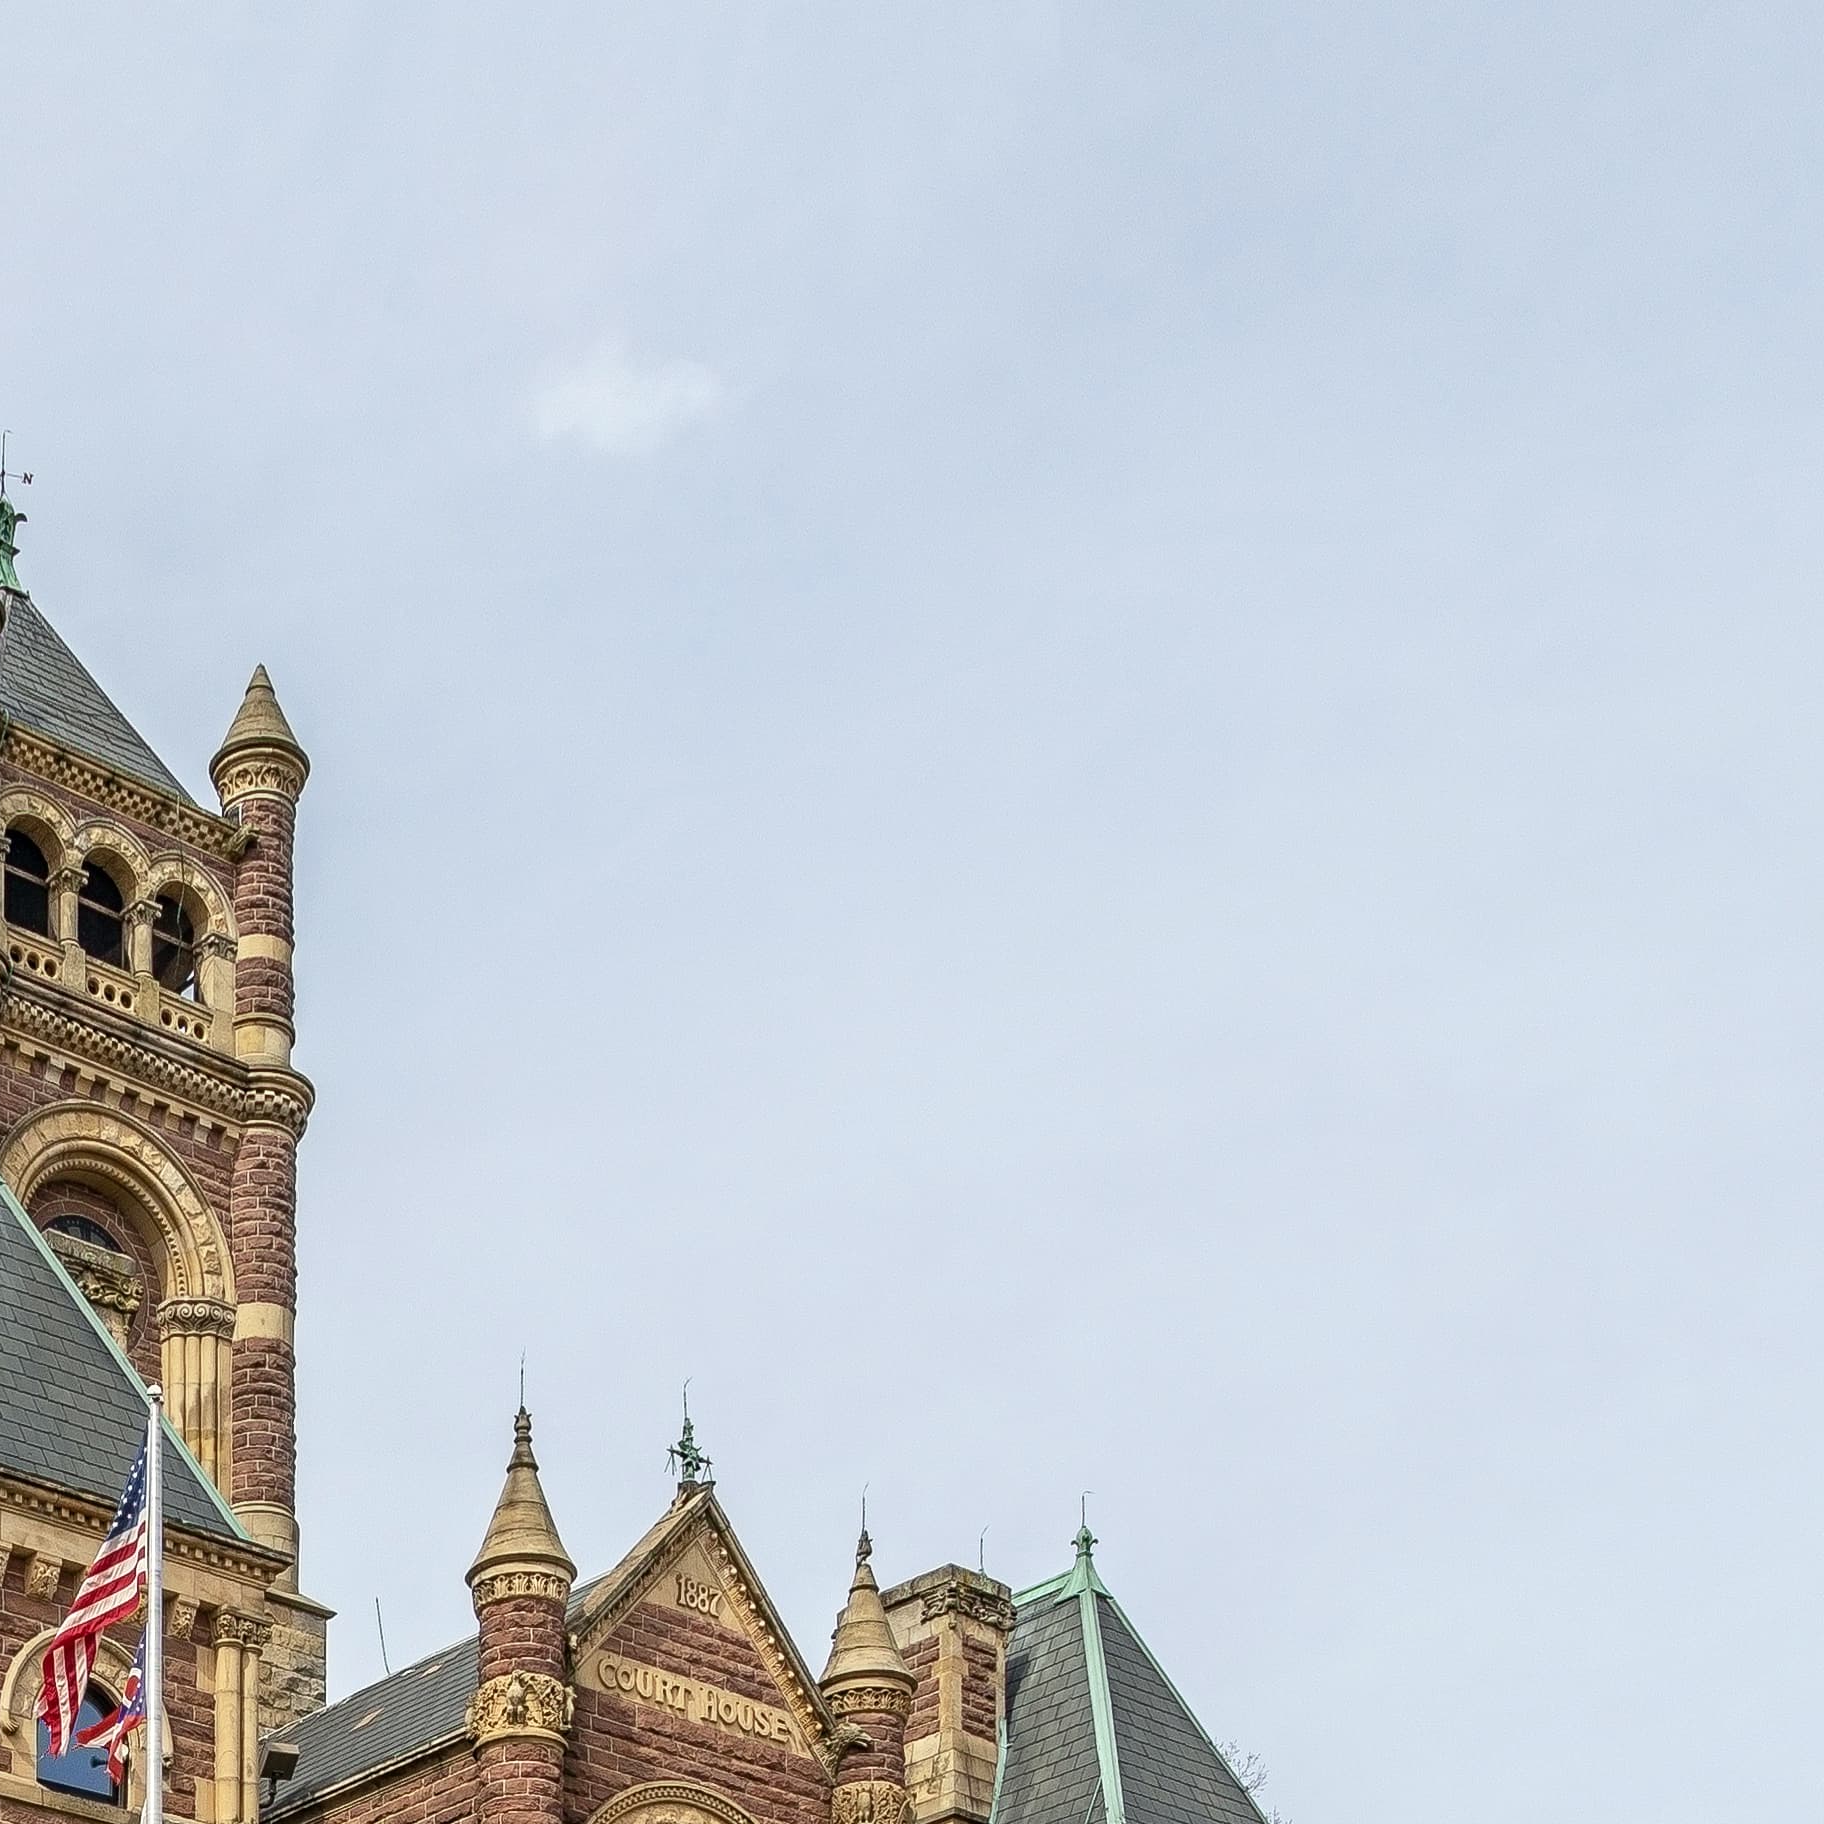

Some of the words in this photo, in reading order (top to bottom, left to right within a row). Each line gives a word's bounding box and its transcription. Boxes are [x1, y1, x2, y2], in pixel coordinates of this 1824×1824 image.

[22, 472, 34, 484] N
[676, 1573, 724, 1617] 1887
[598, 1656, 691, 1711] COURT
[699, 1687, 791, 1743] HOUSE
